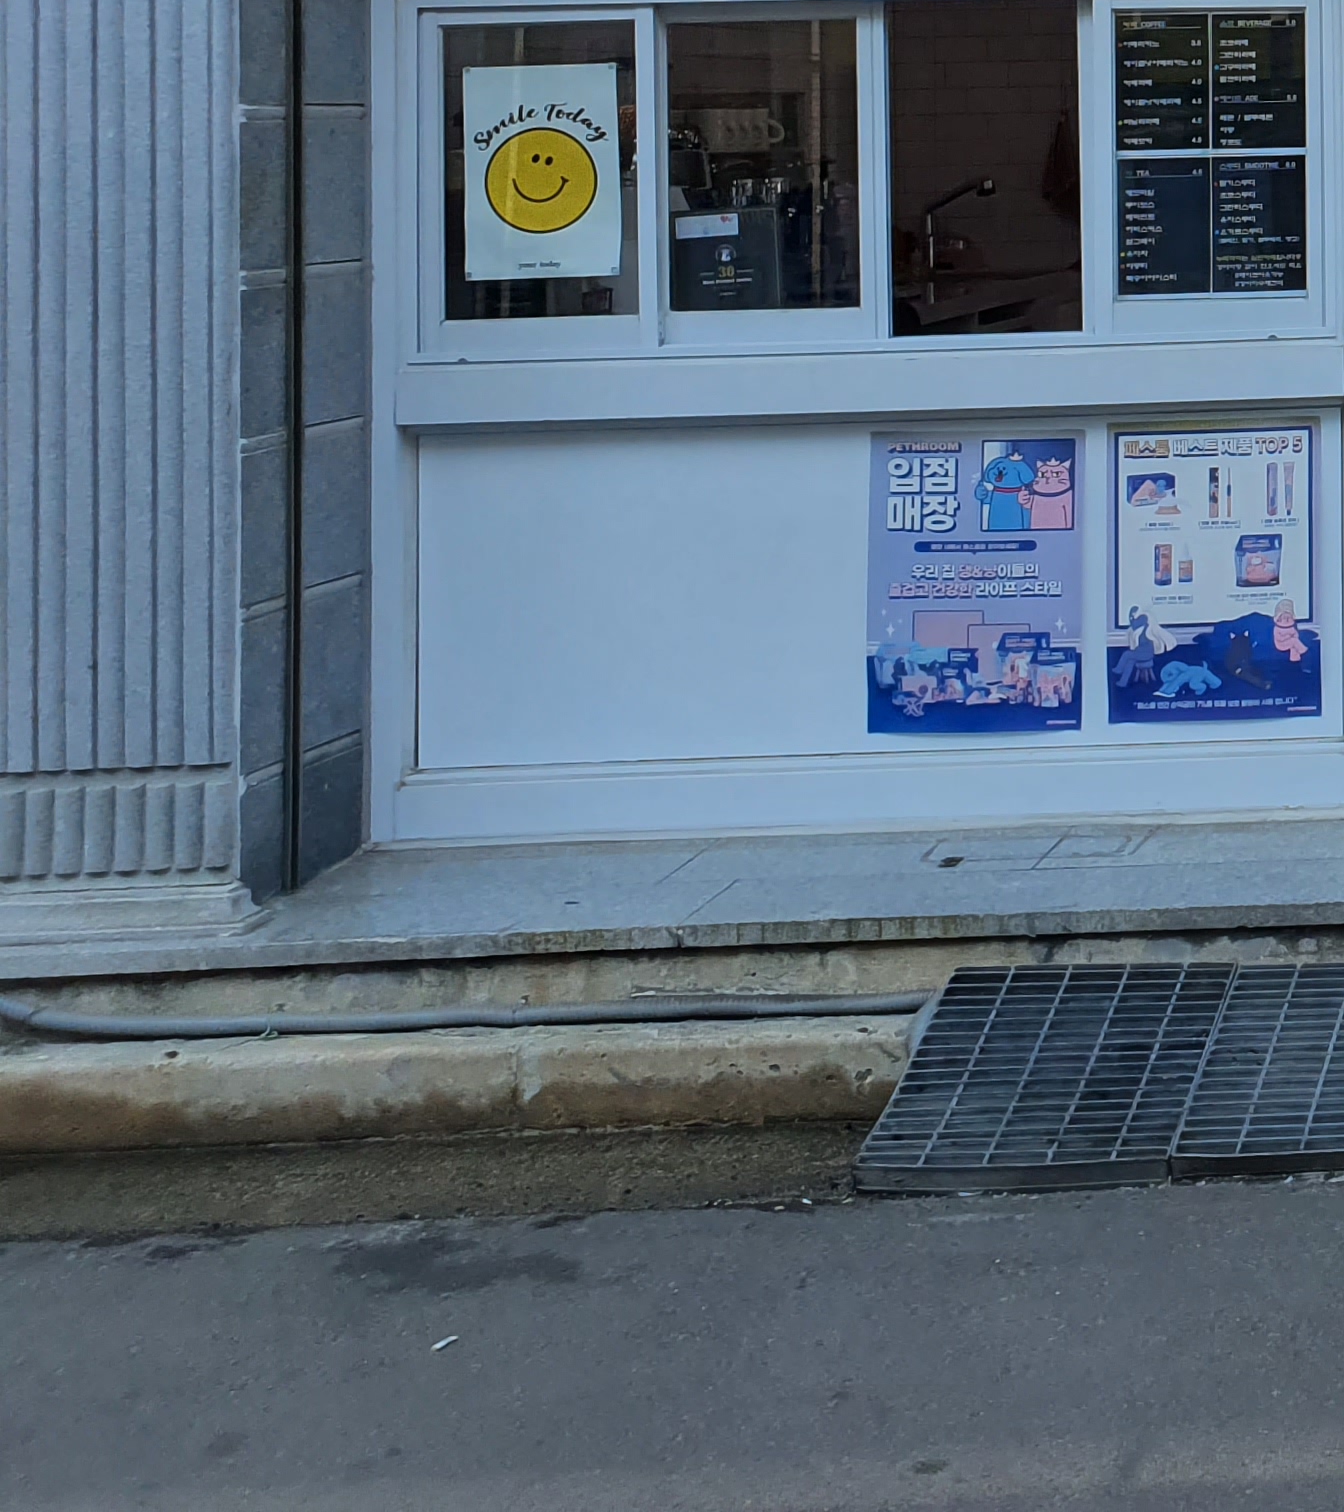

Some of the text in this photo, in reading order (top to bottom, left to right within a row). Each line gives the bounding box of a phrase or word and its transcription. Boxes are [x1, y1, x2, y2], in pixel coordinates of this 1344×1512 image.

[473, 102, 610, 152] Smile Today
[887, 441, 962, 453] PETHROOM
[1173, 438, 1219, 457] 베스트
[1221, 437, 1253, 456] 제품
[1255, 437, 1290, 455] TOP
[1292, 435, 1303, 454] 5
[887, 457, 958, 494] 입점
[886, 495, 961, 533] 매장
[911, 564, 939, 579] 우리
[942, 564, 956, 579] 집
[975, 581, 1018, 598] 라이프
[1019, 580, 1063, 597] 스타일
